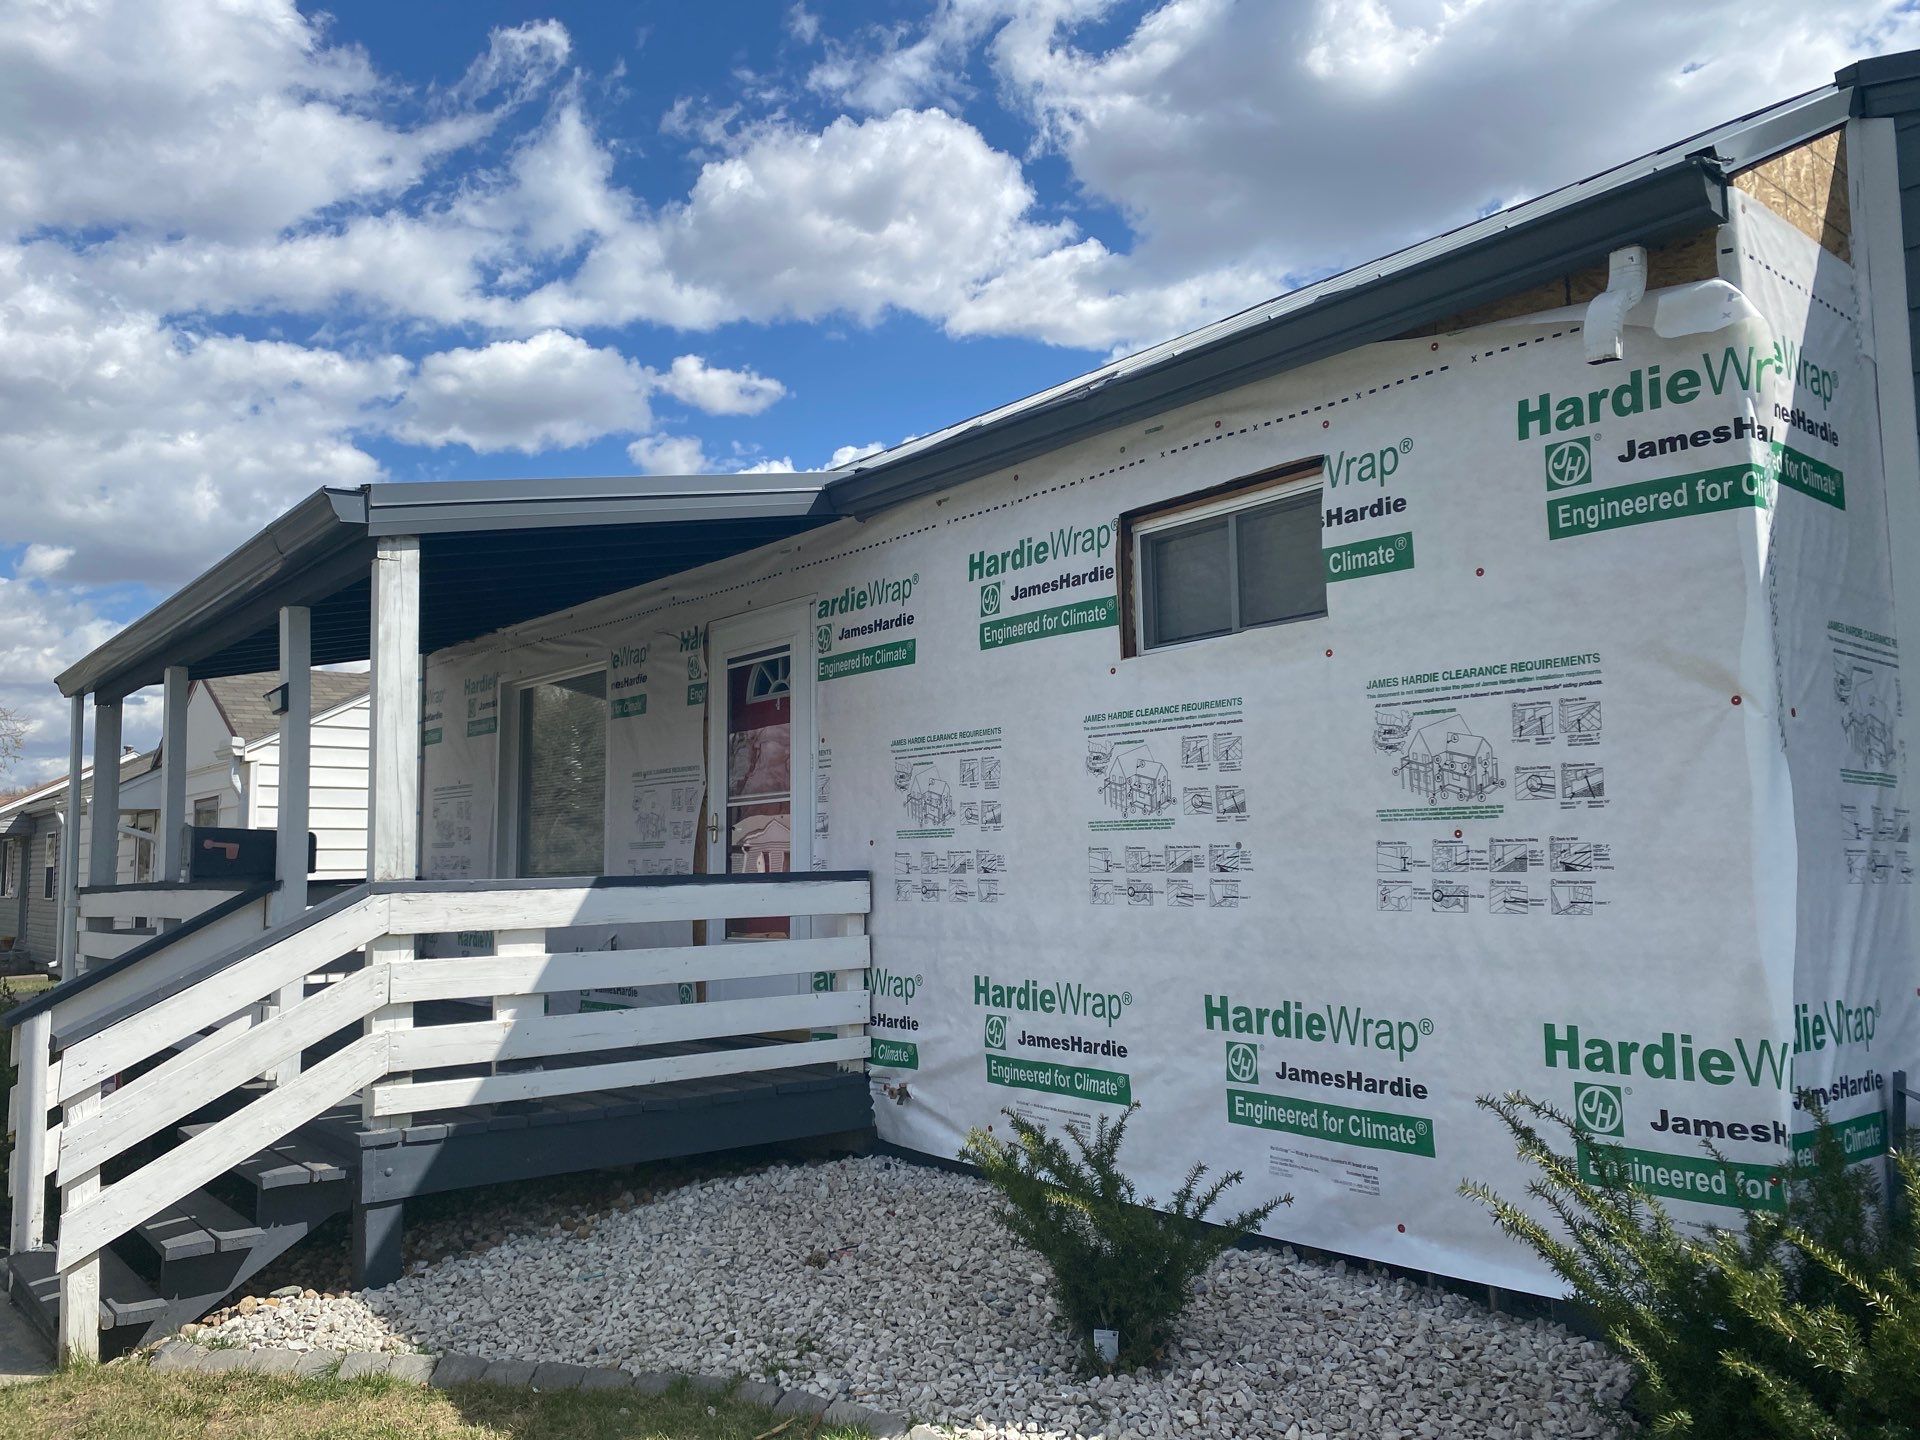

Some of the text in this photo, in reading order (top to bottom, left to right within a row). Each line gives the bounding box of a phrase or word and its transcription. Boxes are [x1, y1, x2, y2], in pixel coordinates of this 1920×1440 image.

[1785, 456, 1799, 480] for
[1557, 471, 1767, 529] Engineered for Cli
[1010, 565, 1114, 601] JamesHardie
[838, 613, 915, 640] JamesHardie
[984, 616, 1040, 644] Engineered
[1043, 614, 1058, 630] for
[820, 657, 860, 677] Engineered
[862, 653, 873, 667] for
[1366, 652, 1601, 690] JAMES HARDIE CLEARANCE REQUIREMENTS
[1083, 697, 1243, 723] JAMES HARDIE CLEARANCE REQUIREMENTS
[891, 738, 907, 747] JAMES
[908, 736, 926, 745] HARDIE
[926, 732, 957, 743] CLEARANCE
[959, 727, 1002, 739] REQUIREMENTS
[1018, 1030, 1128, 1058] JamesHardie
[991, 1060, 1051, 1086] Engineered
[1054, 1069, 1070, 1088] for
[1275, 1061, 1428, 1100] JamesHardie
[1235, 1096, 1318, 1129] Engineered
[1322, 1110, 1344, 1134] for
[1650, 1109, 1790, 1148] JamesH
